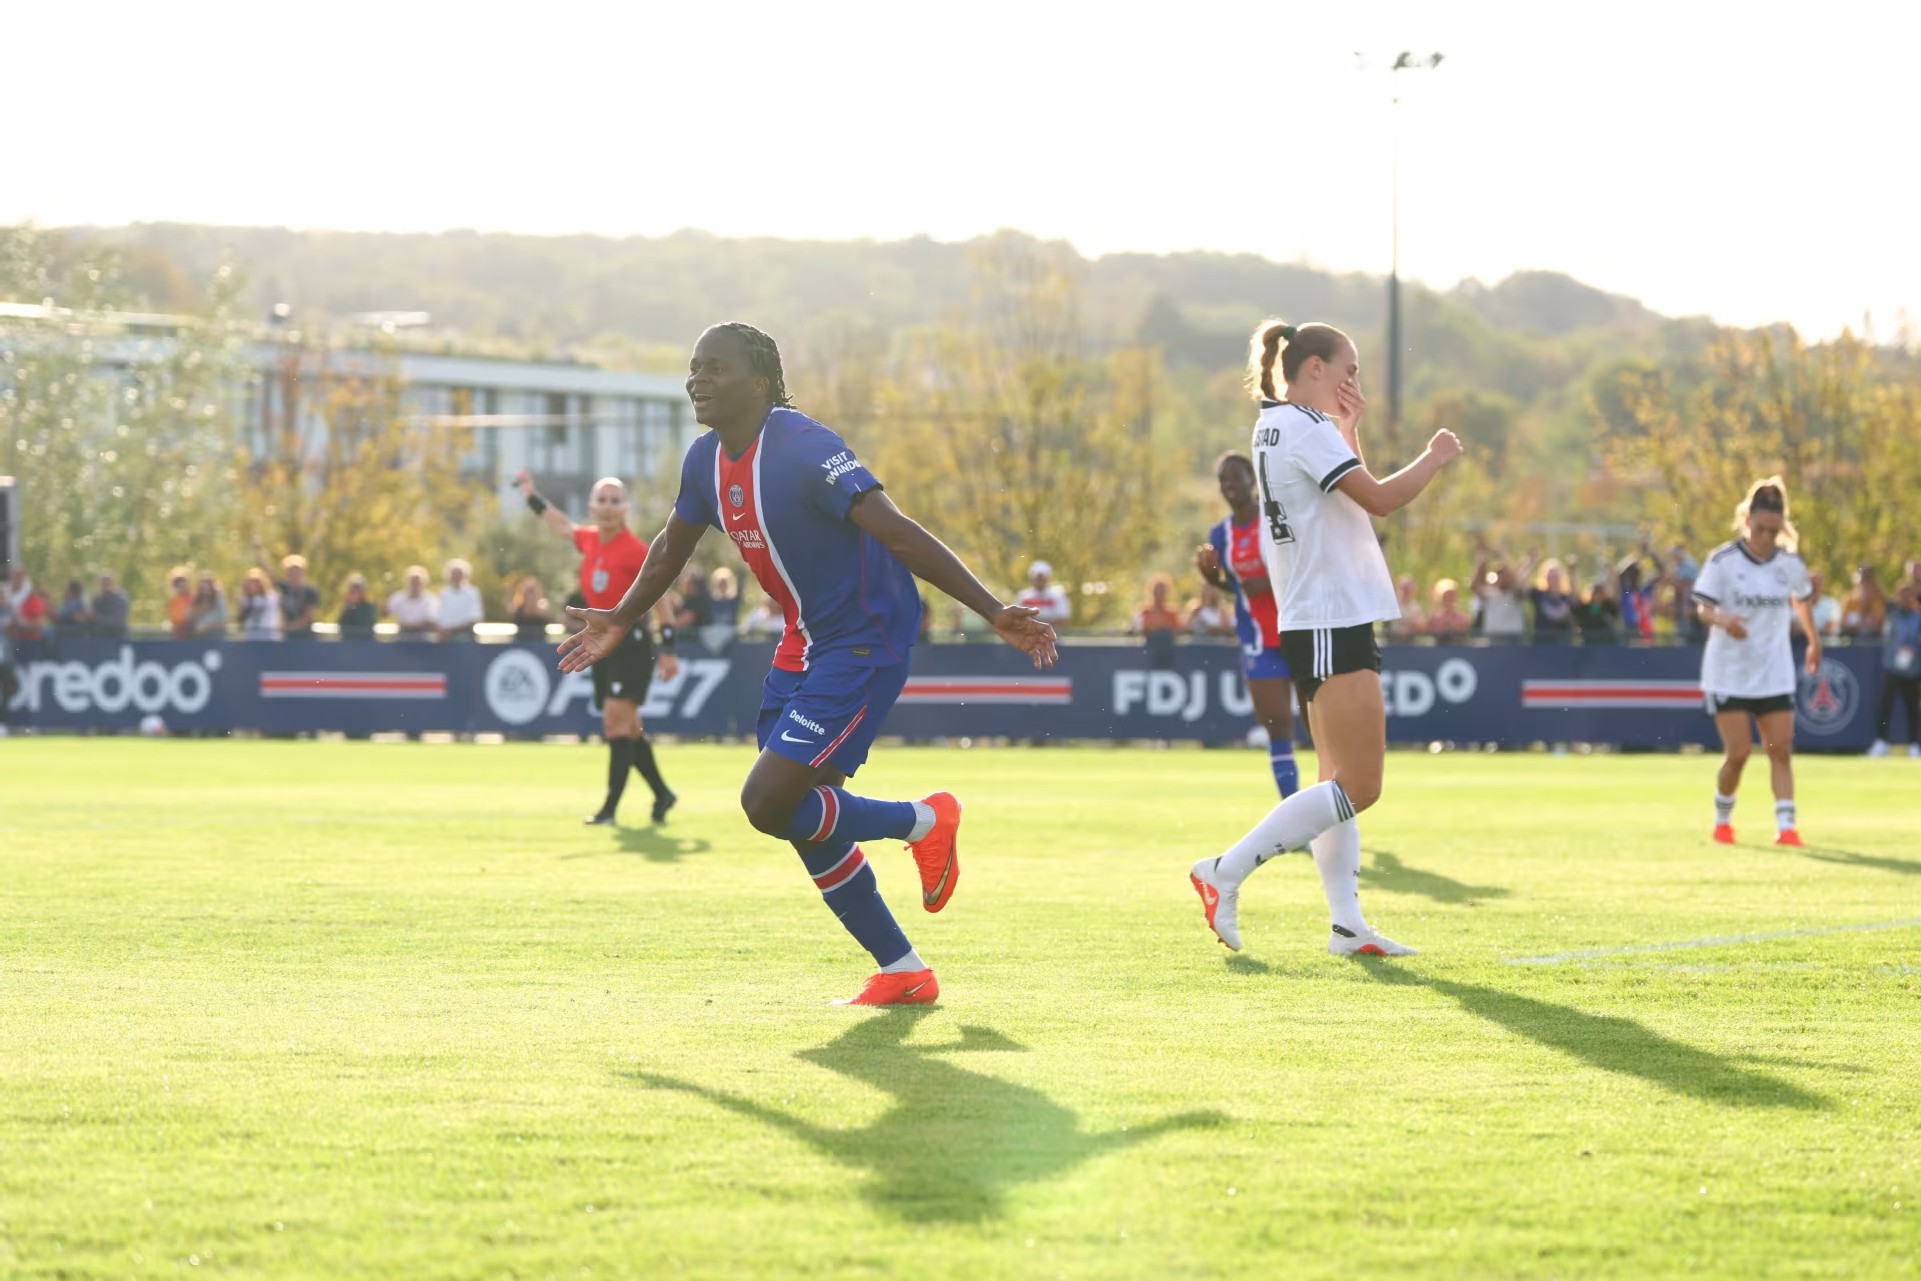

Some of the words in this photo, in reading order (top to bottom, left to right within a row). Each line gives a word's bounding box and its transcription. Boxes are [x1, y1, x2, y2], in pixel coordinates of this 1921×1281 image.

[821, 451, 848, 470] VISIT
[730, 529, 761, 543] QATAR
[1112, 669, 1207, 721] FDJ
[789, 709, 825, 735] Deloitte
